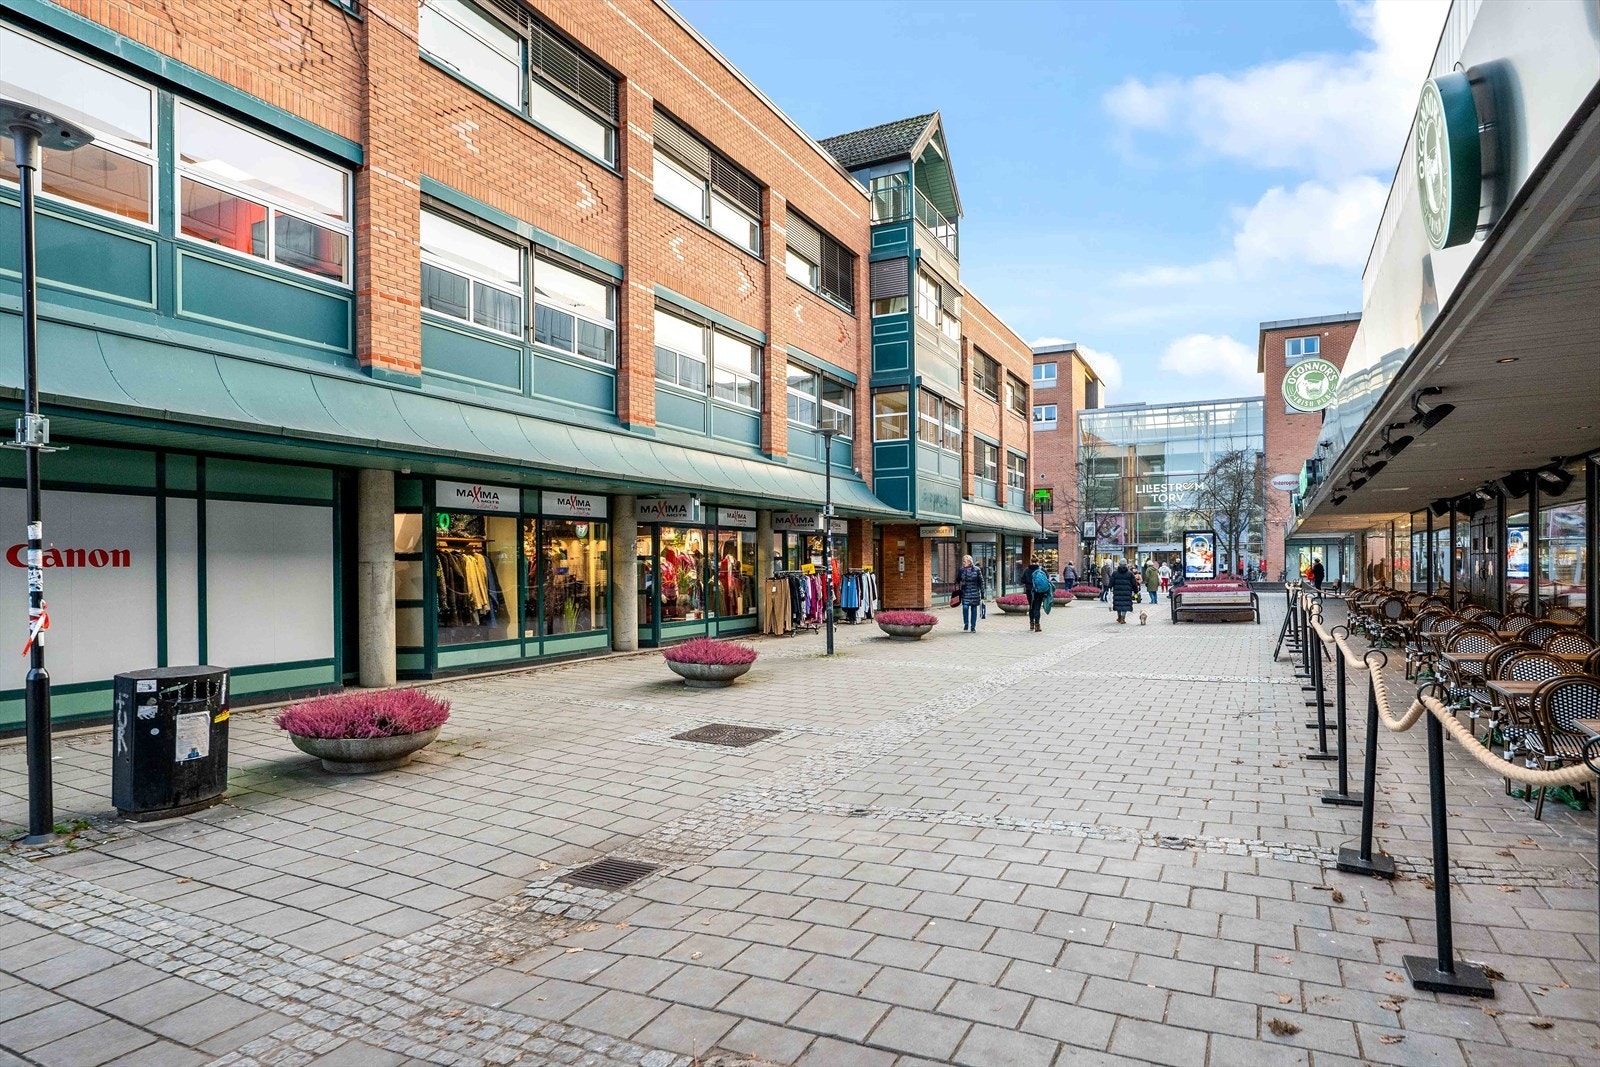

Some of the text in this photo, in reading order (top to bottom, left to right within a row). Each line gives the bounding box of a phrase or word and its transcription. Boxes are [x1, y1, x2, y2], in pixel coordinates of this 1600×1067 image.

[1288, 362, 1337, 384] O'CONNOR'S
[1294, 394, 1331, 407] IRISH PUB
[456, 486, 499, 504] MAXIMA
[1151, 493, 1184, 503] TORV
[557, 496, 591, 511] MAXIMA
[640, 501, 687, 518] MAXIMA
[775, 514, 815, 527] MAXIMA
[6, 543, 130, 568] Canon
